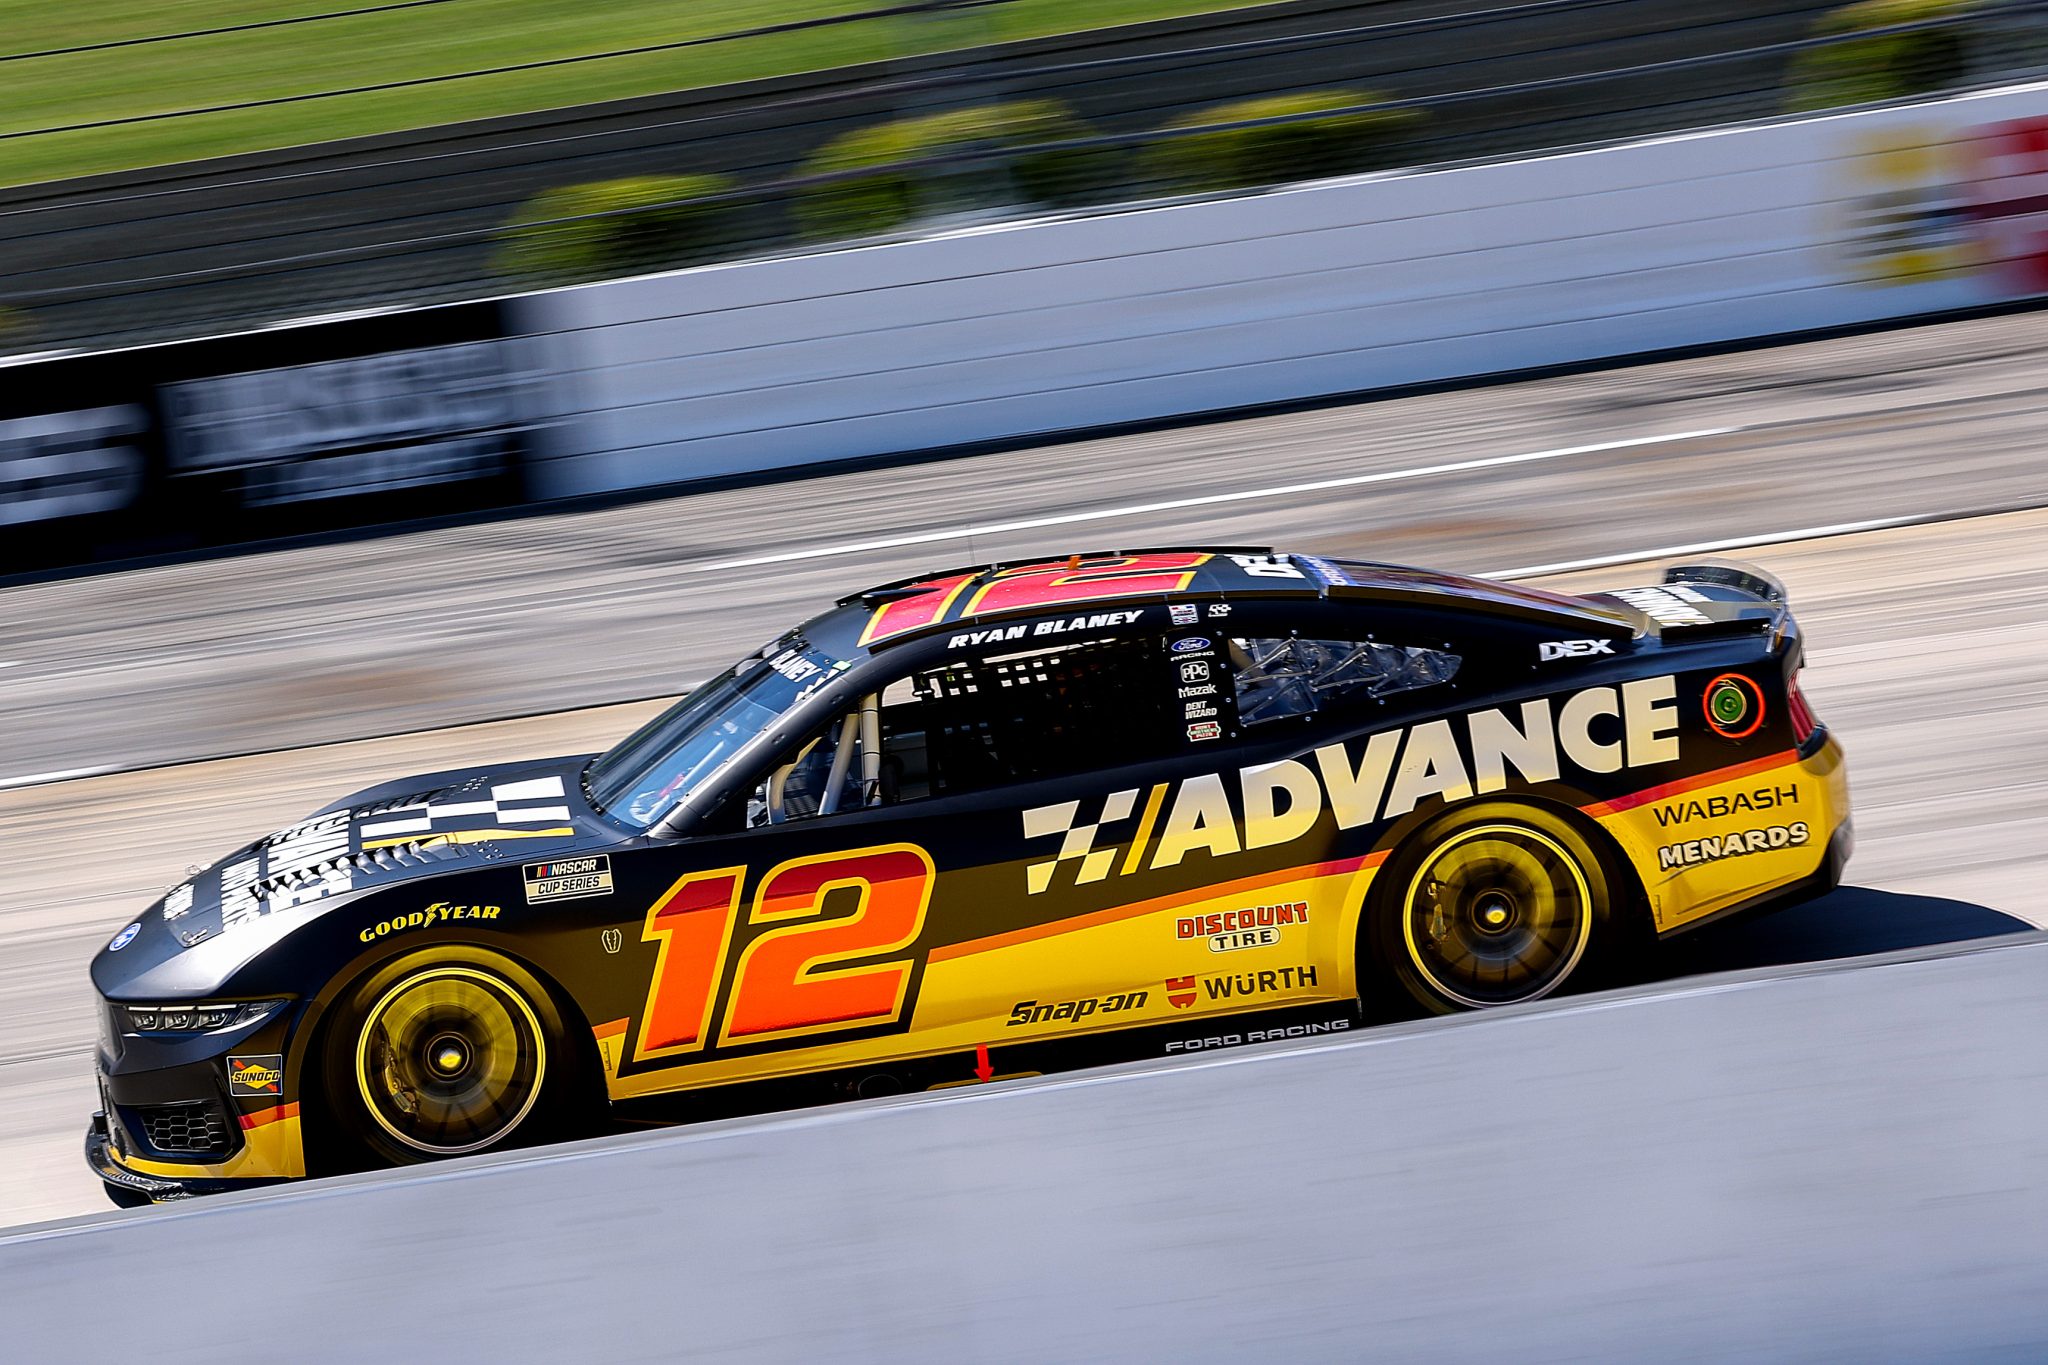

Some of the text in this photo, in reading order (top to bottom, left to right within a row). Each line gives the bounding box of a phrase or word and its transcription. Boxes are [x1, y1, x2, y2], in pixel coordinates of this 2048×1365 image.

[947, 625, 1027, 649] RYAN
[1033, 610, 1144, 636] BLANEY
[1539, 639, 1616, 661] DEX
[1182, 663, 1208, 680] PPG
[1178, 683, 1217, 698] Mazak
[1185, 701, 1207, 711] DENT
[1185, 707, 1218, 719] WIZARD
[1149, 675, 1680, 870] ADVANCE
[1653, 783, 1800, 827] WABASH
[1658, 822, 1811, 871] MENARDS
[551, 859, 597, 876] NASCAR
[538, 876, 600, 894] CUP SERIES
[359, 903, 501, 942] GOODYEAR
[1177, 903, 1308, 938] DISCOUNT
[633, 842, 936, 1062] 12
[1215, 930, 1274, 950] TIRE
[1006, 991, 1149, 1026] Snap-on
[1166, 1019, 1350, 1052] FORD RACING
[234, 1070, 279, 1082] SUNOCO
